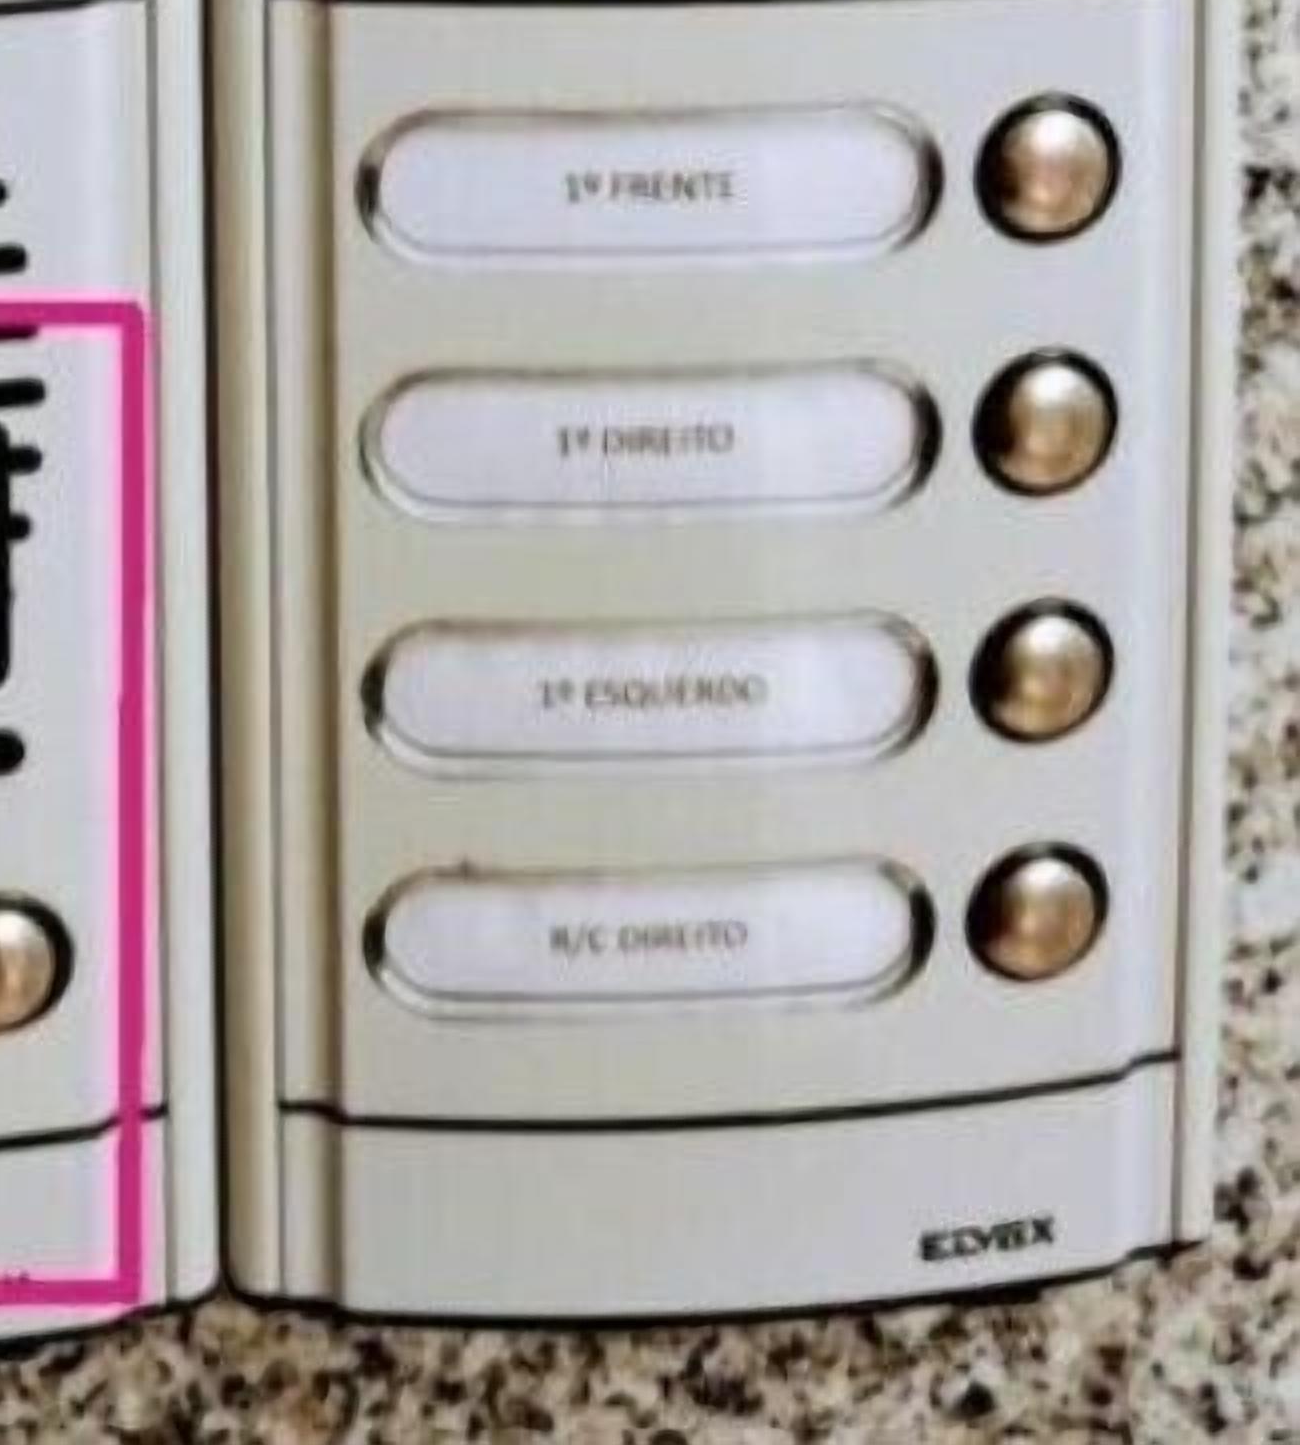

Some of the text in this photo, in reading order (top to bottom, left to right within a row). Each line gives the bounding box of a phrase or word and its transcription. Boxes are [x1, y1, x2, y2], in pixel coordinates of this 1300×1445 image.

[608, 169, 737, 202] FRENTE
[602, 423, 736, 457] DIREITO
[584, 673, 769, 710] ESQUERDO
[549, 918, 749, 958] R/C DIREITO
